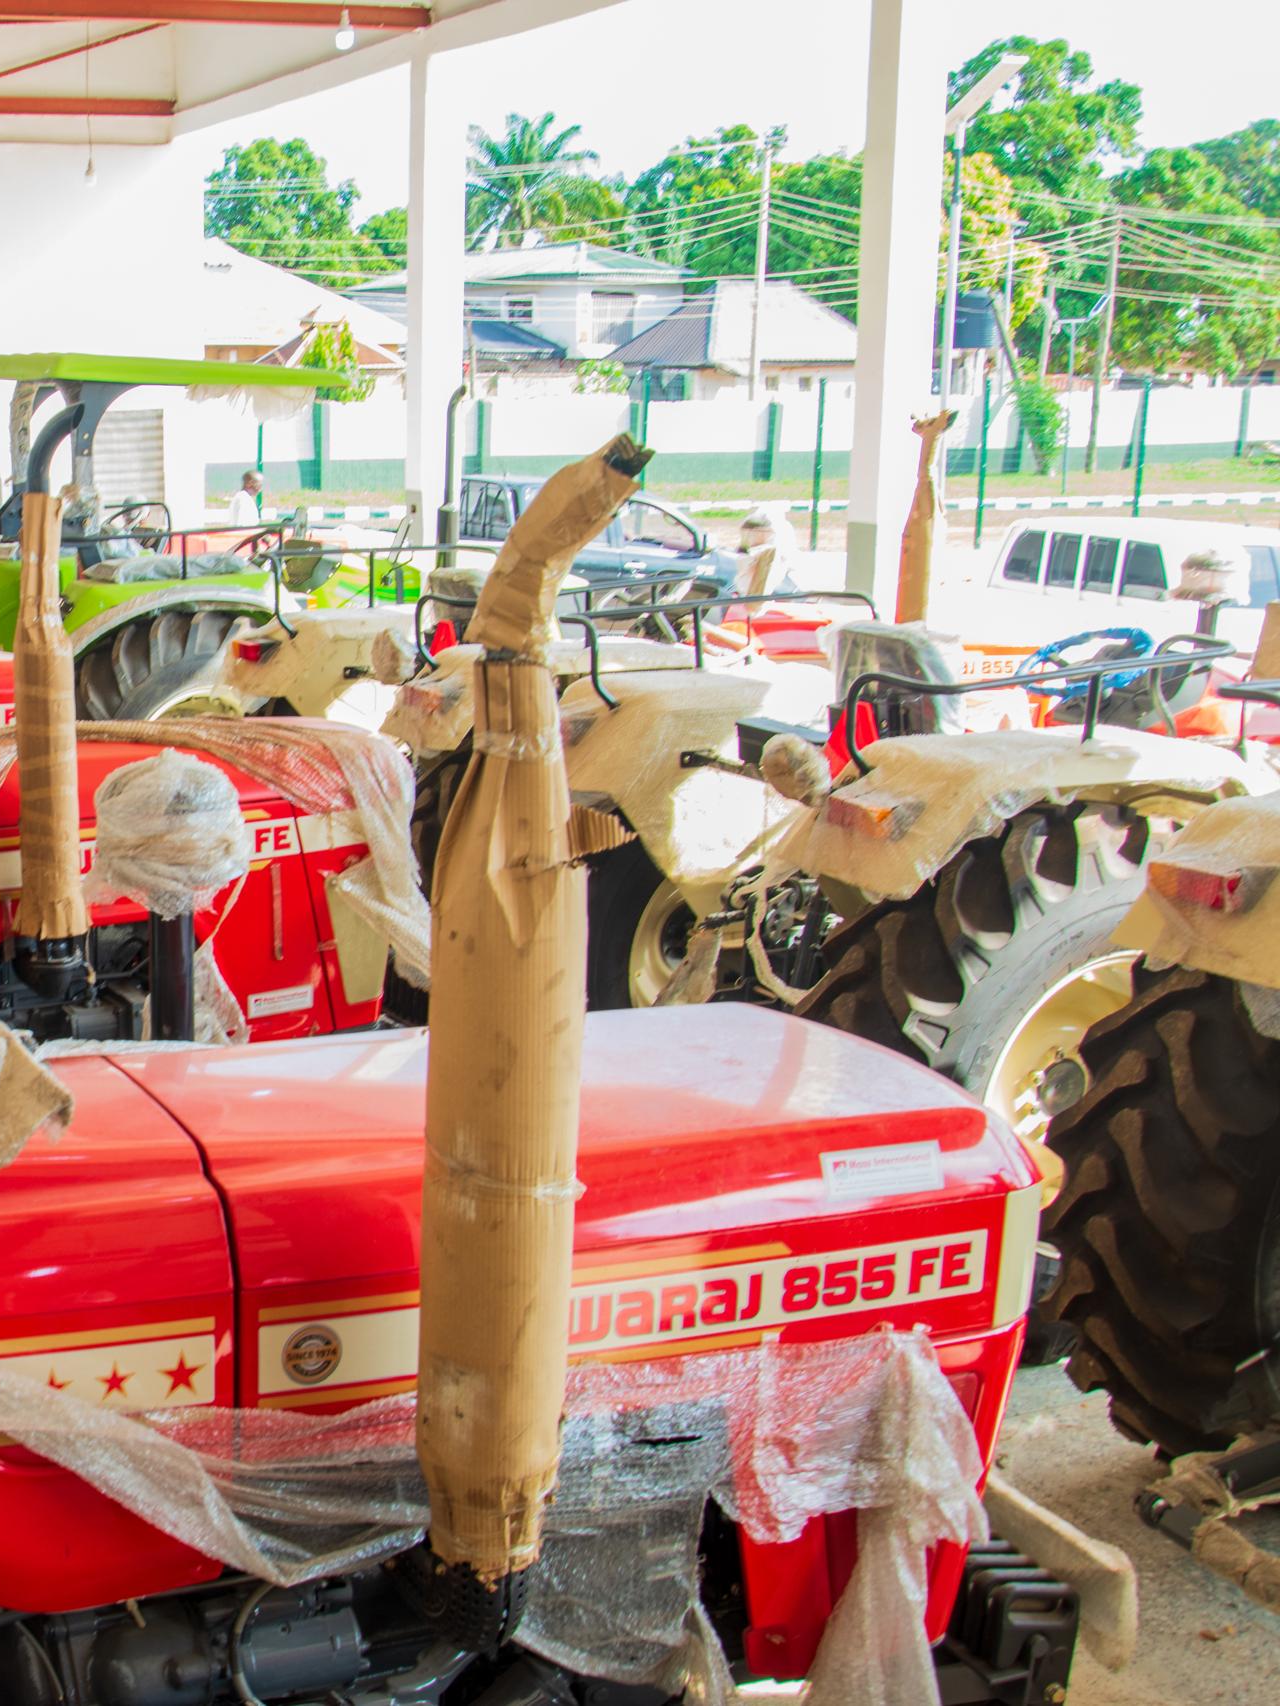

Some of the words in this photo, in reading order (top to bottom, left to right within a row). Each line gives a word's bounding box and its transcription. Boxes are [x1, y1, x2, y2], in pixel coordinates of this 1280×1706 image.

[255, 825, 291, 853] FE
[782, 1253, 897, 1314] 855
[907, 1241, 972, 1294] FE
